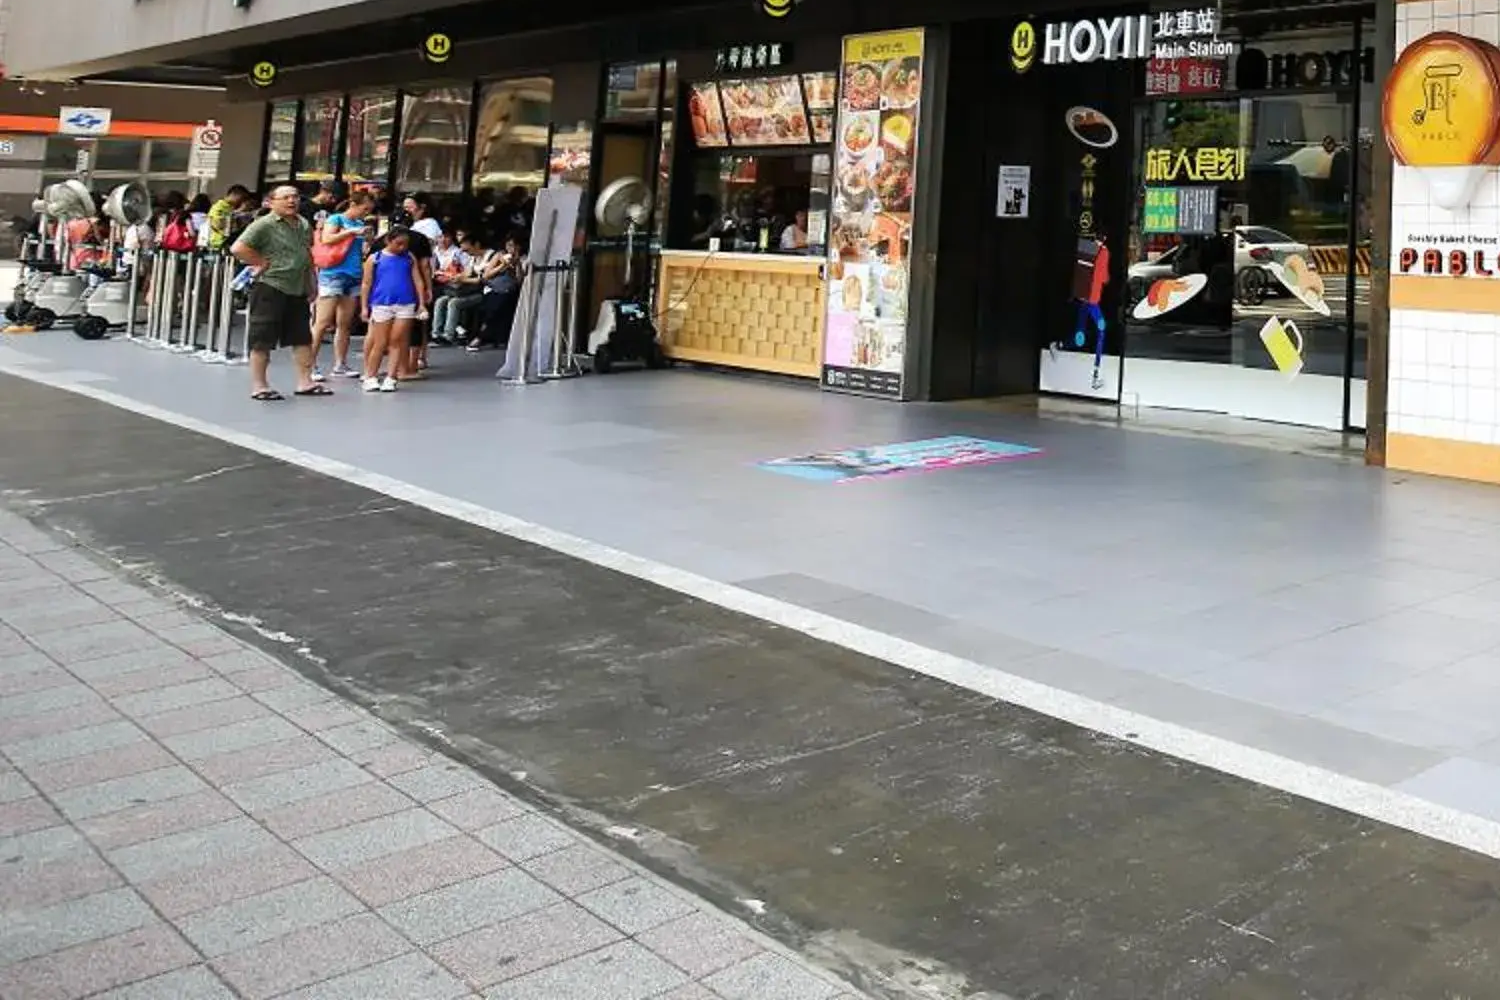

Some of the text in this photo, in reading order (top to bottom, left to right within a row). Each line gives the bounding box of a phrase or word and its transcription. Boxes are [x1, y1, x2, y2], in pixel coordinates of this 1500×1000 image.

[1043, 7, 1215, 65] HOYII 北車站
[1155, 40, 1233, 58] Main Station
[1145, 147, 1246, 181] 旅人食刻
[1408, 234, 1438, 244] Freshly
[1440, 234, 1465, 244] Baked
[1468, 235, 1497, 245] Cheese
